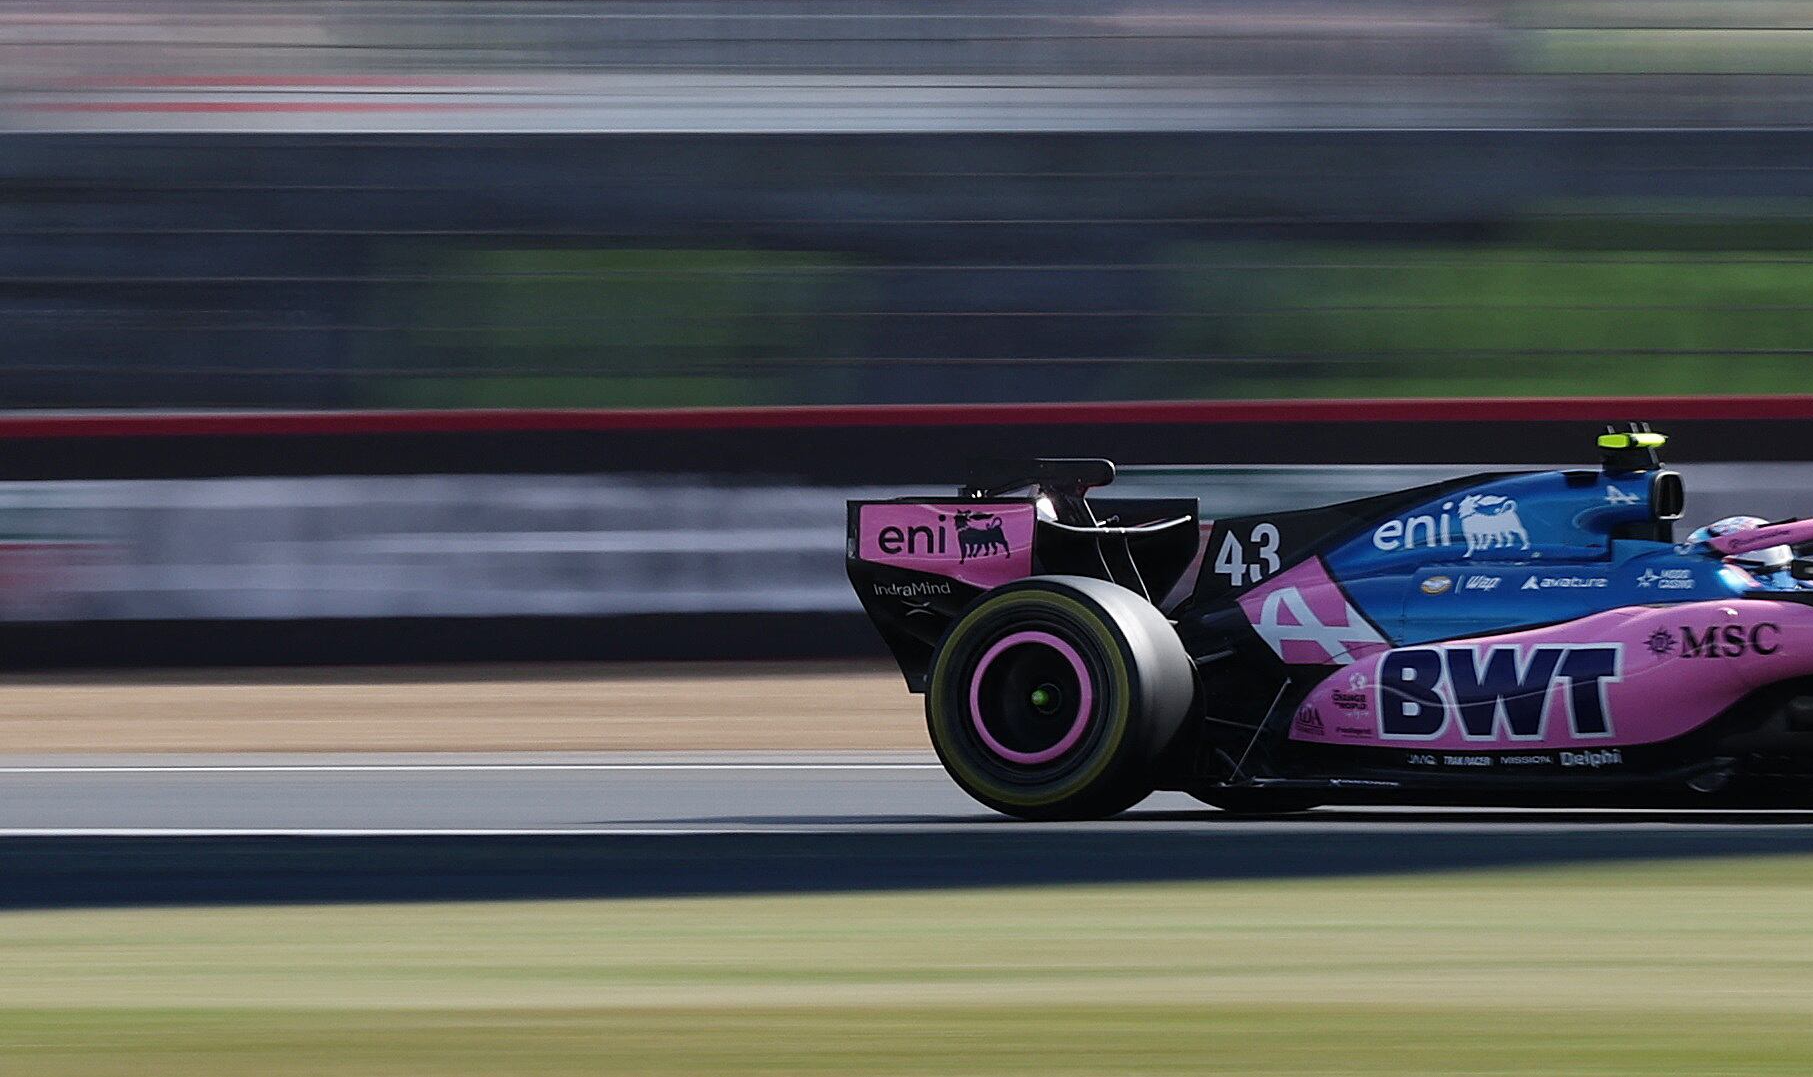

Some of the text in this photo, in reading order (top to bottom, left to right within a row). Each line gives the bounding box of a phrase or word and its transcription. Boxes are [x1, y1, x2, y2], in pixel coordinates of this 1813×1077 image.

[878, 514, 946, 555] eni
[1372, 501, 1453, 551] eni
[1214, 523, 1281, 587] 43
[872, 582, 950, 596] IndraMind
[1679, 622, 1782, 659] MSC
[1375, 641, 1625, 742] BWT
[1559, 748, 1623, 768] Delphi
